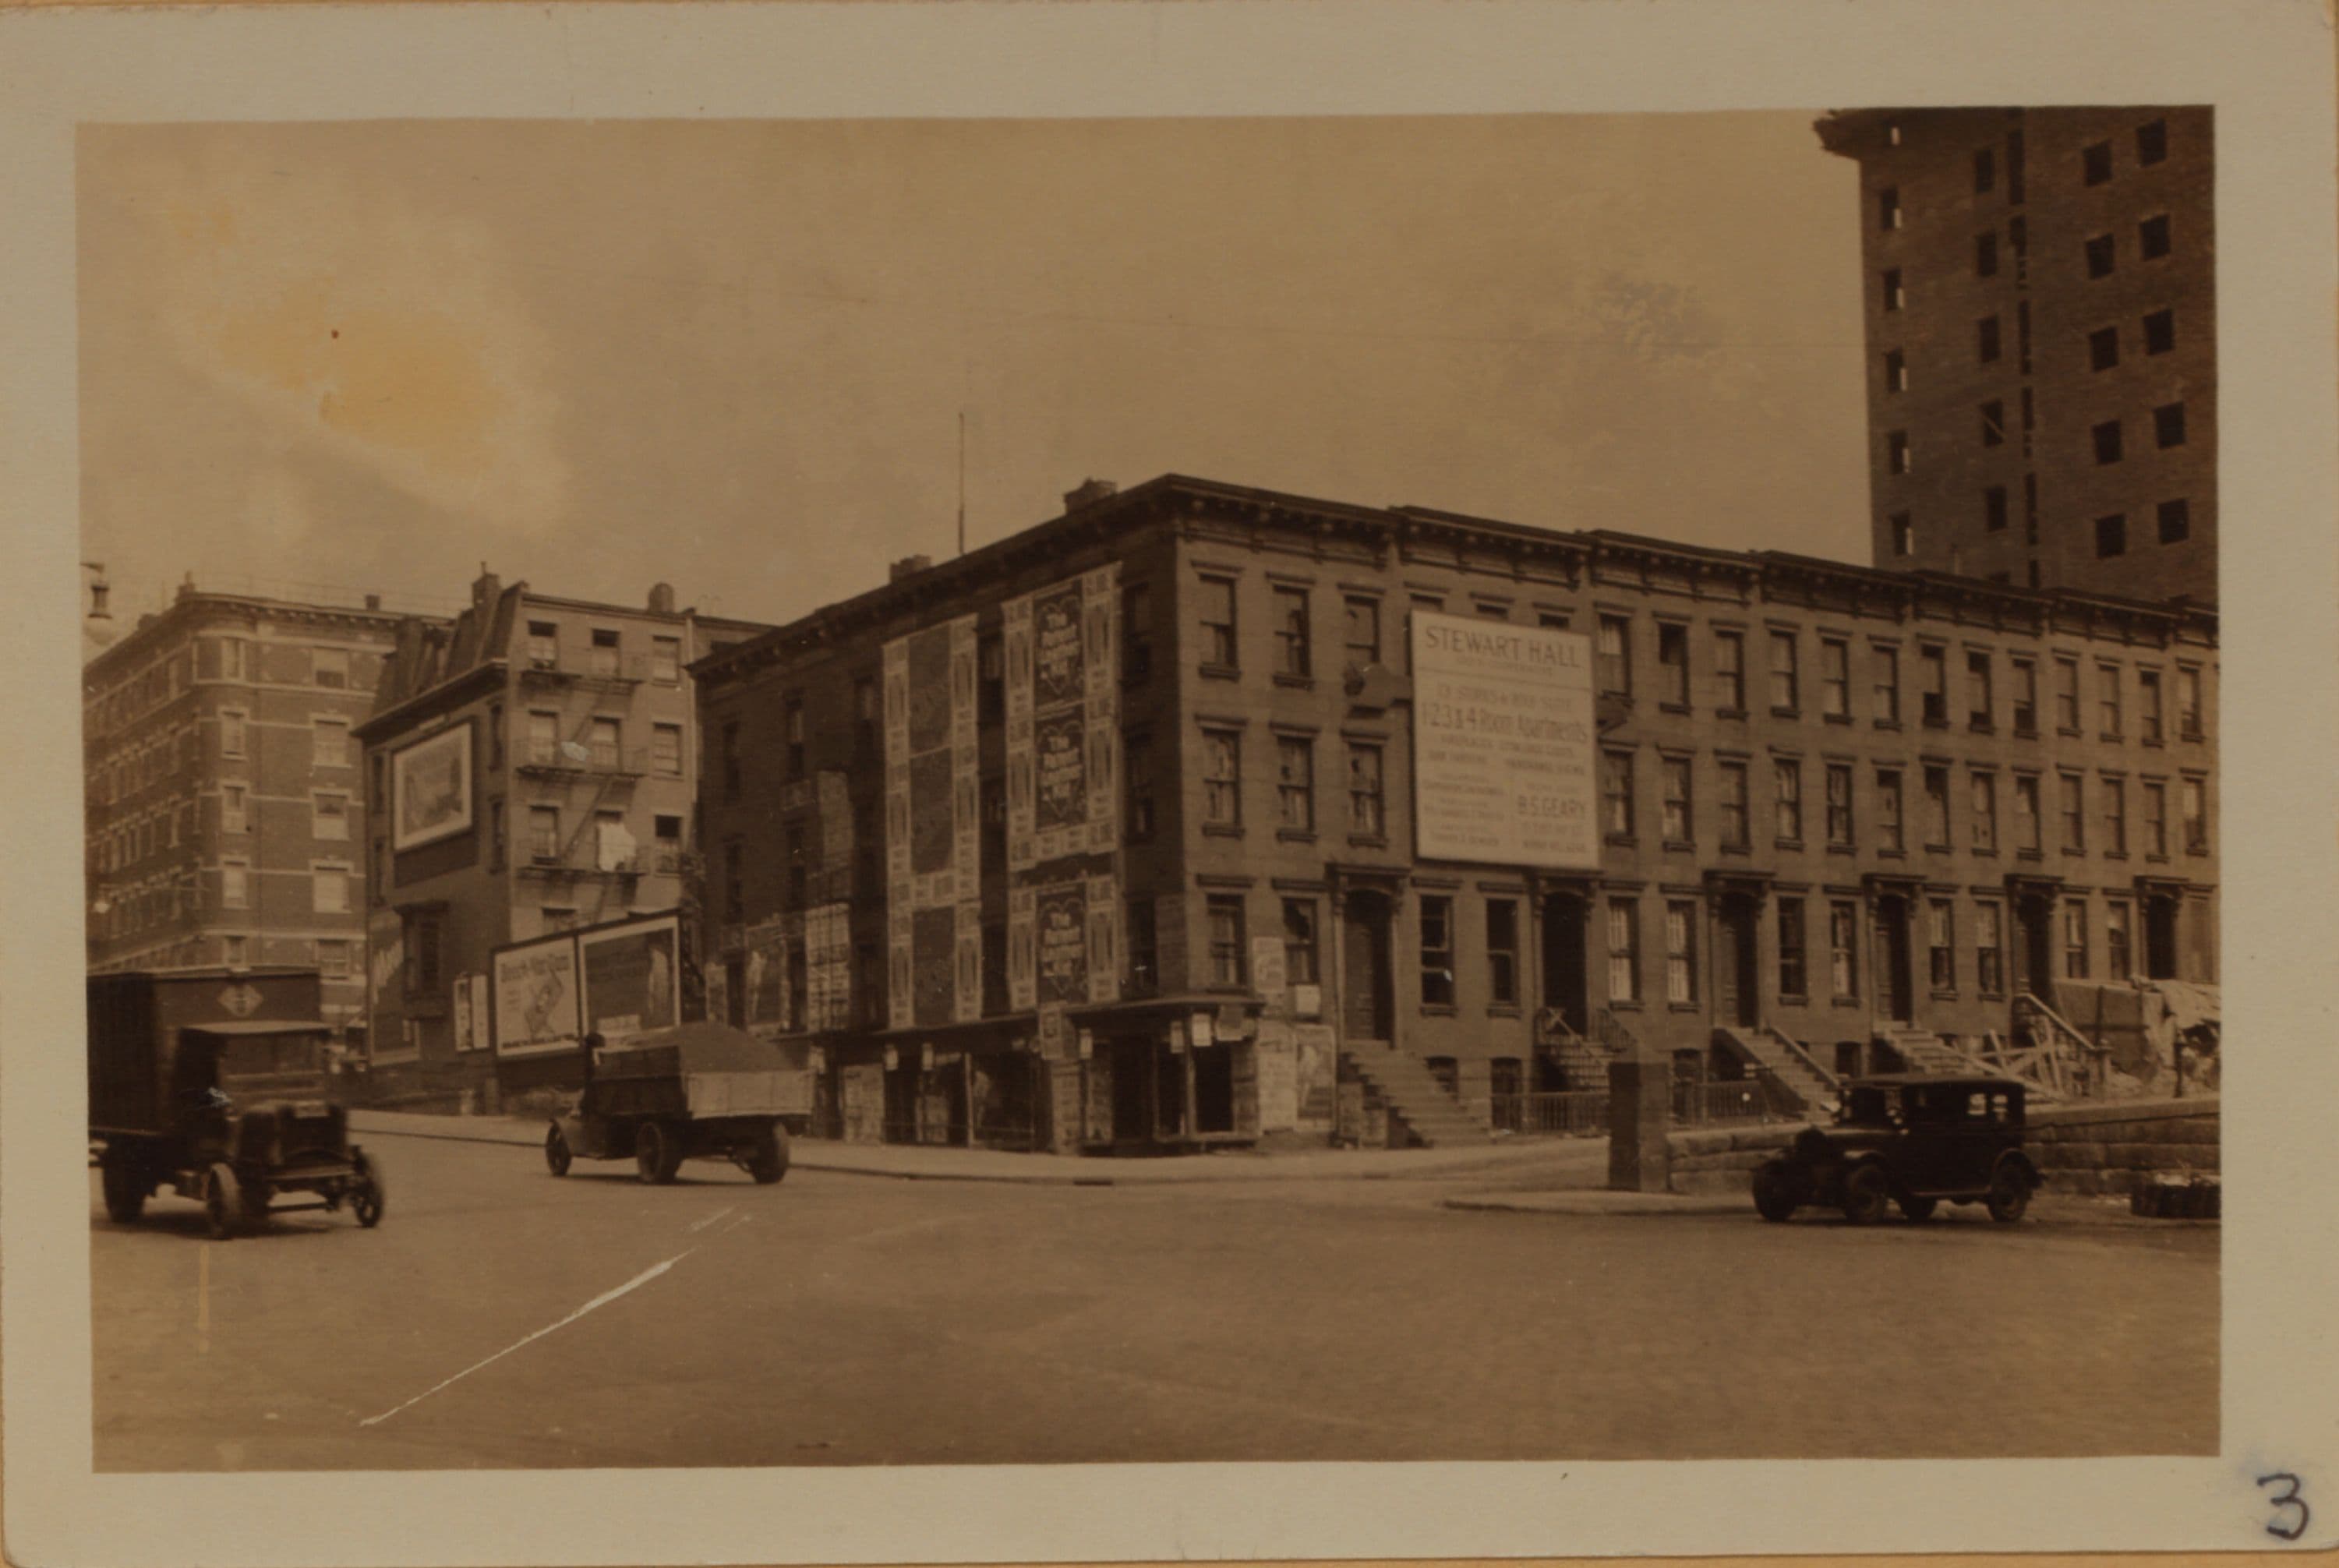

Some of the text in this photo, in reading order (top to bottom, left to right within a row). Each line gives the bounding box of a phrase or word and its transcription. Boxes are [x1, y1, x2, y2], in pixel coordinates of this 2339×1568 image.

[1426, 625, 1522, 661] STEWART
[1528, 639, 1581, 668] HALL
[2256, 1473, 2310, 1541] 3
